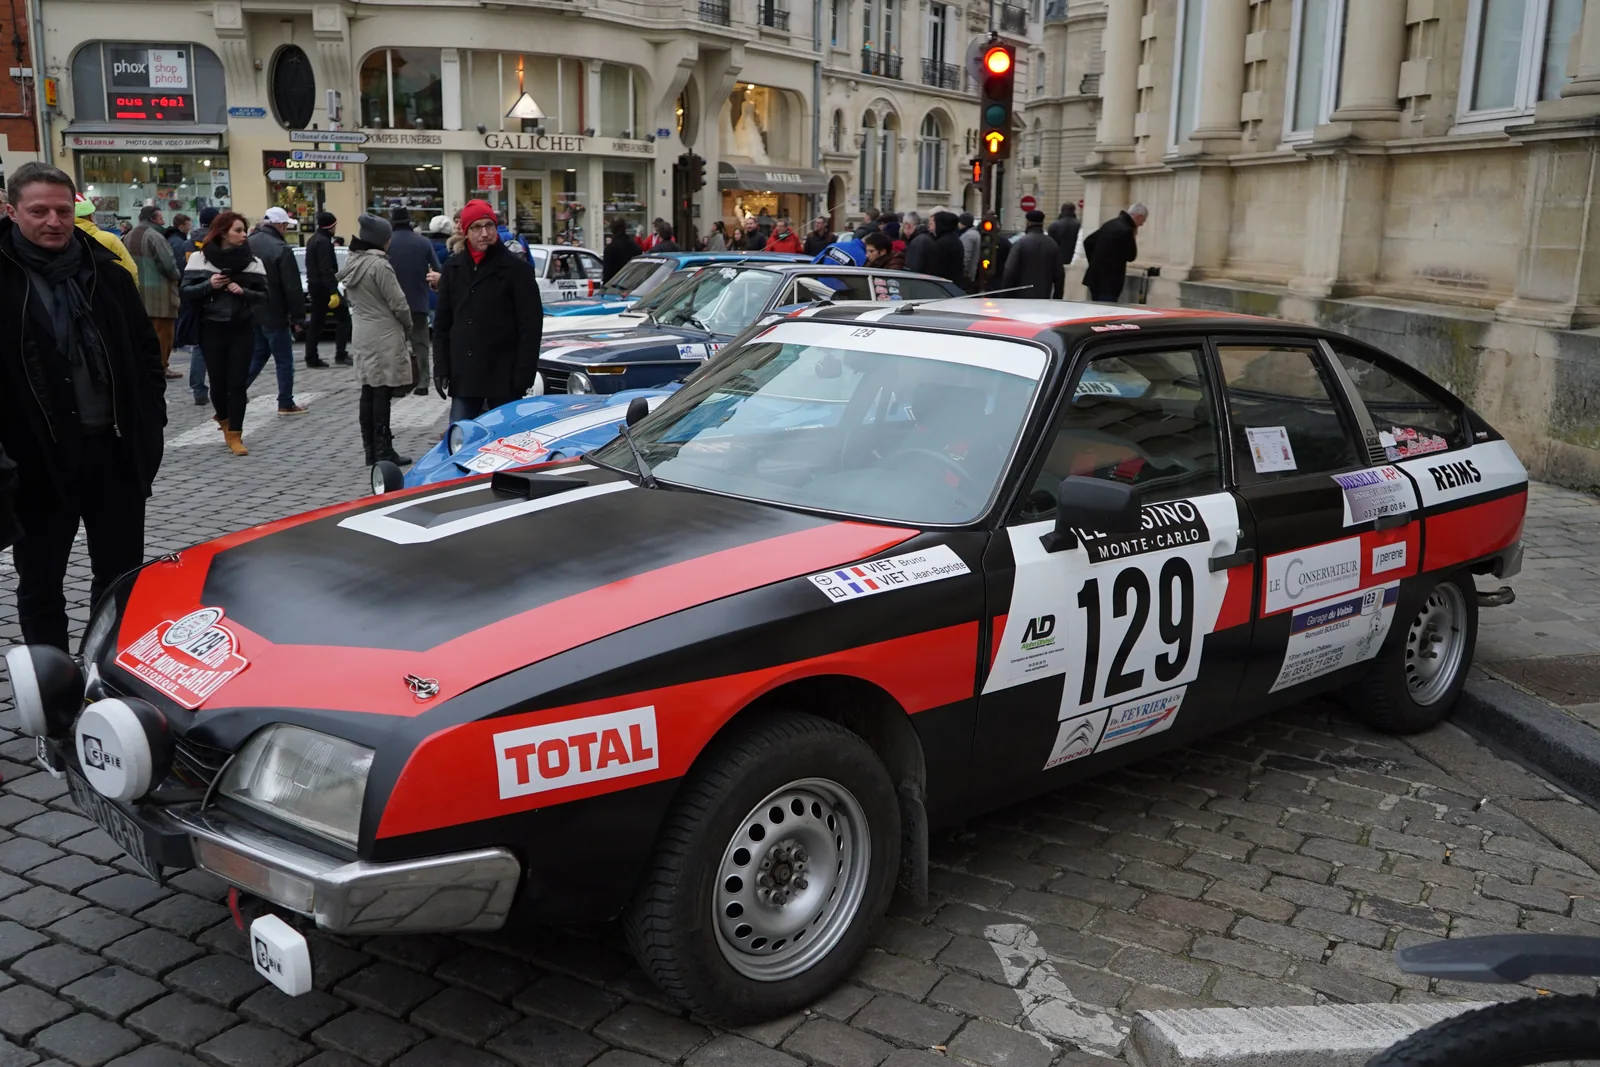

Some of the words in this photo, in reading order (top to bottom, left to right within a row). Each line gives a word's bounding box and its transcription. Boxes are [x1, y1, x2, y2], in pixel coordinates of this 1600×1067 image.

[154, 52, 162, 62] le
[113, 59, 146, 76] phox
[154, 63, 178, 74] shop
[155, 74, 183, 85] photo
[294, 132, 319, 140] Tribunal
[330, 133, 363, 141] Commerce
[368, 134, 399, 144] POMPES
[485, 134, 584, 151] GALICHET
[304, 152, 349, 161] Promenades
[765, 172, 802, 182] MAYFAIR
[850, 328, 876, 338] 129
[1336, 469, 1384, 491] DIESELEC
[1428, 459, 1482, 491] REIMS
[864, 560, 897, 573] VIET
[898, 555, 926, 567] Bruno
[876, 571, 910, 586] VIET
[911, 561, 967, 580] Jean-Baptiste
[1269, 578, 1281, 593] LE
[1284, 558, 1358, 600] CONSERVATEUR
[1307, 613, 1328, 626] Garage
[1328, 609, 1336, 620] du
[1336, 605, 1354, 617] Valois
[1363, 592, 1376, 606] 123
[1077, 556, 1194, 706] 129
[186, 630, 226, 657] 129
[126, 629, 164, 665] RALLYE
[152, 653, 233, 698] MONTE-CARLO
[135, 663, 180, 693] HISTORIQUE
[1121, 699, 1168, 723] FEVRIER
[504, 723, 654, 785] TOTAL
